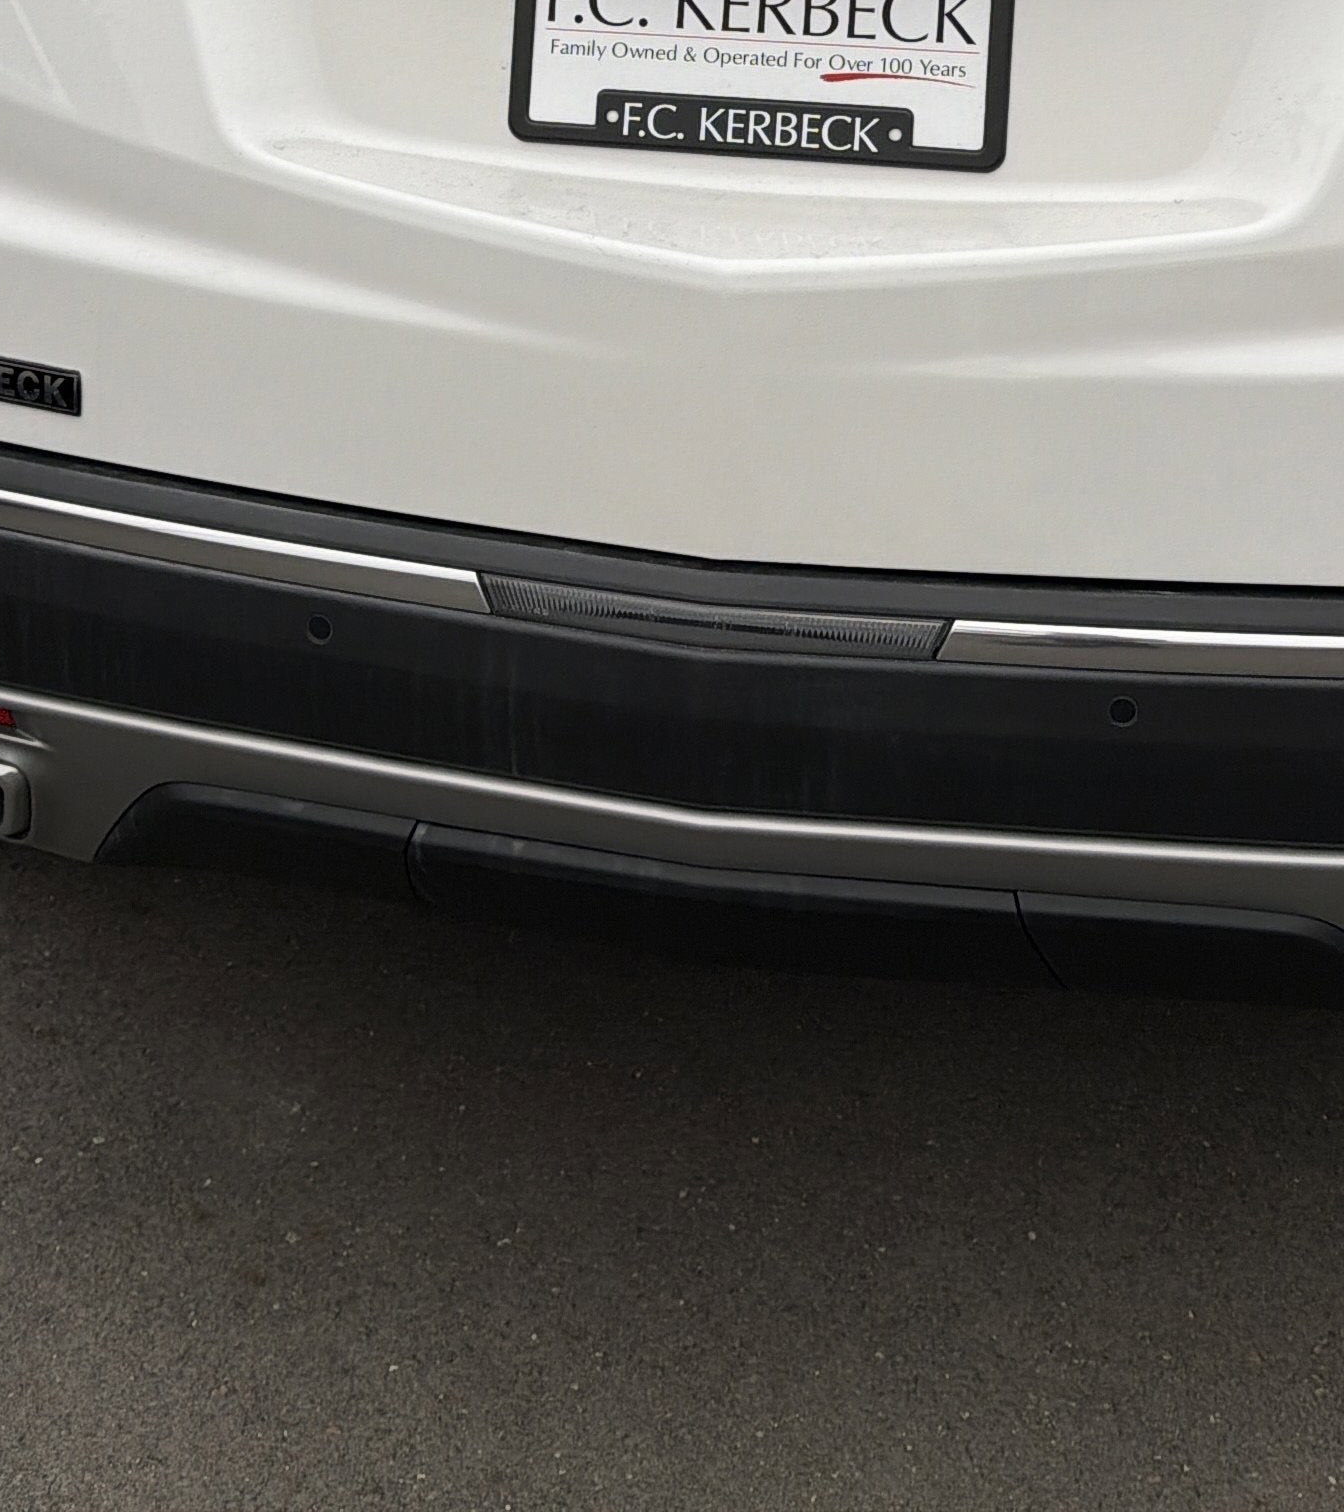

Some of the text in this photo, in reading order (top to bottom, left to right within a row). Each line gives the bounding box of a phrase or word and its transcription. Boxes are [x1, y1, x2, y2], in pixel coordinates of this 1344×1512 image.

[549, 38, 967, 78] Family Owned & Operated For Over 100 Years
[621, 101, 883, 153] F.C. KERBECK
